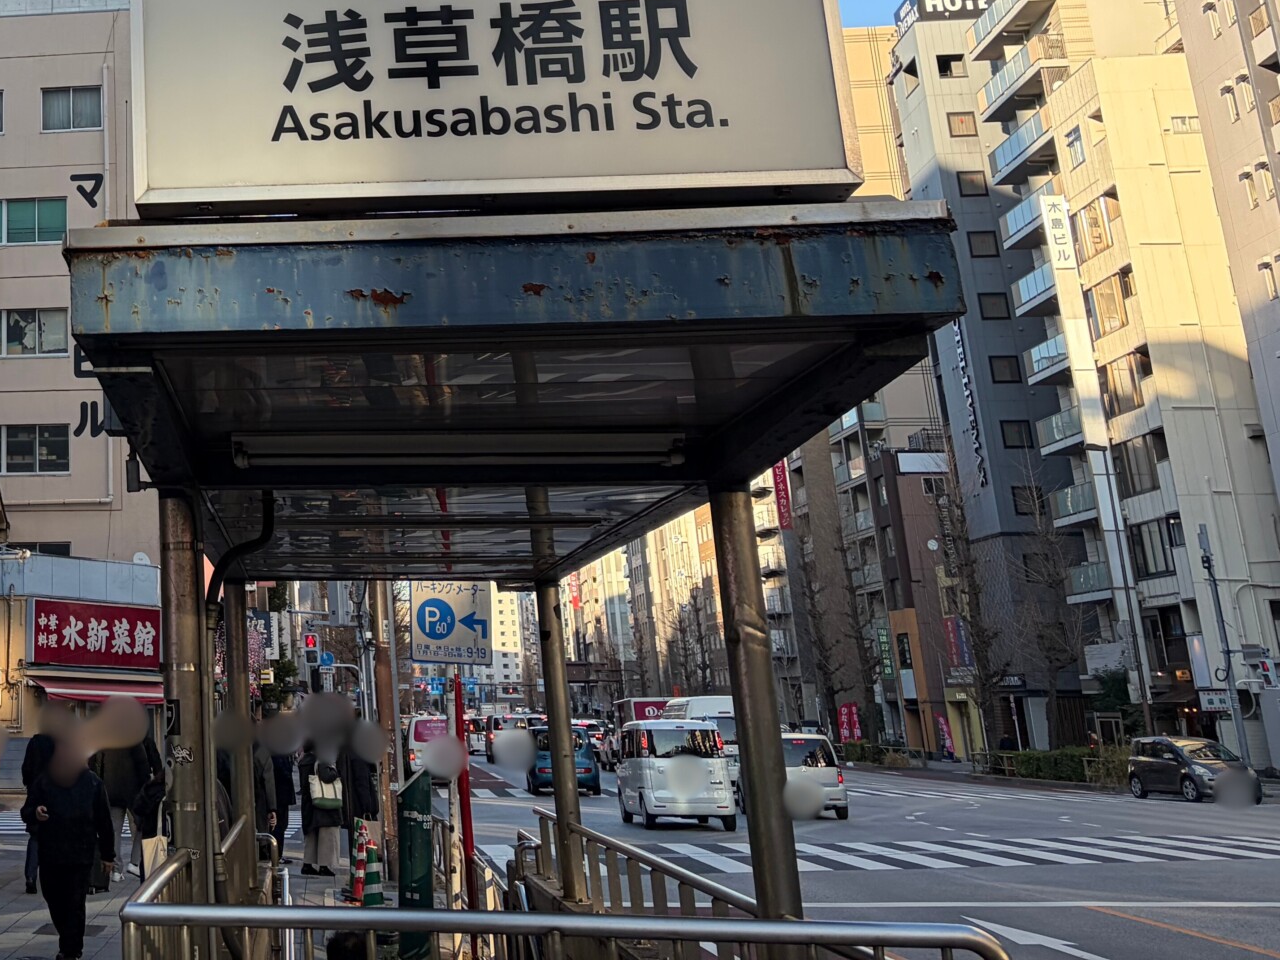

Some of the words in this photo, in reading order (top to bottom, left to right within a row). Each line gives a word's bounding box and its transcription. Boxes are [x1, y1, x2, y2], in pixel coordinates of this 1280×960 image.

[271, 91, 616, 142] Asakusabashi
[633, 91, 730, 131] Sta.
[1047, 202, 1070, 261] 木島ビル
[37, 612, 59, 632] 中華
[425, 607, 440, 633] P
[436, 622, 447, 634] 60
[37, 632, 58, 648] 料理
[61, 615, 156, 657] 水新菜館
